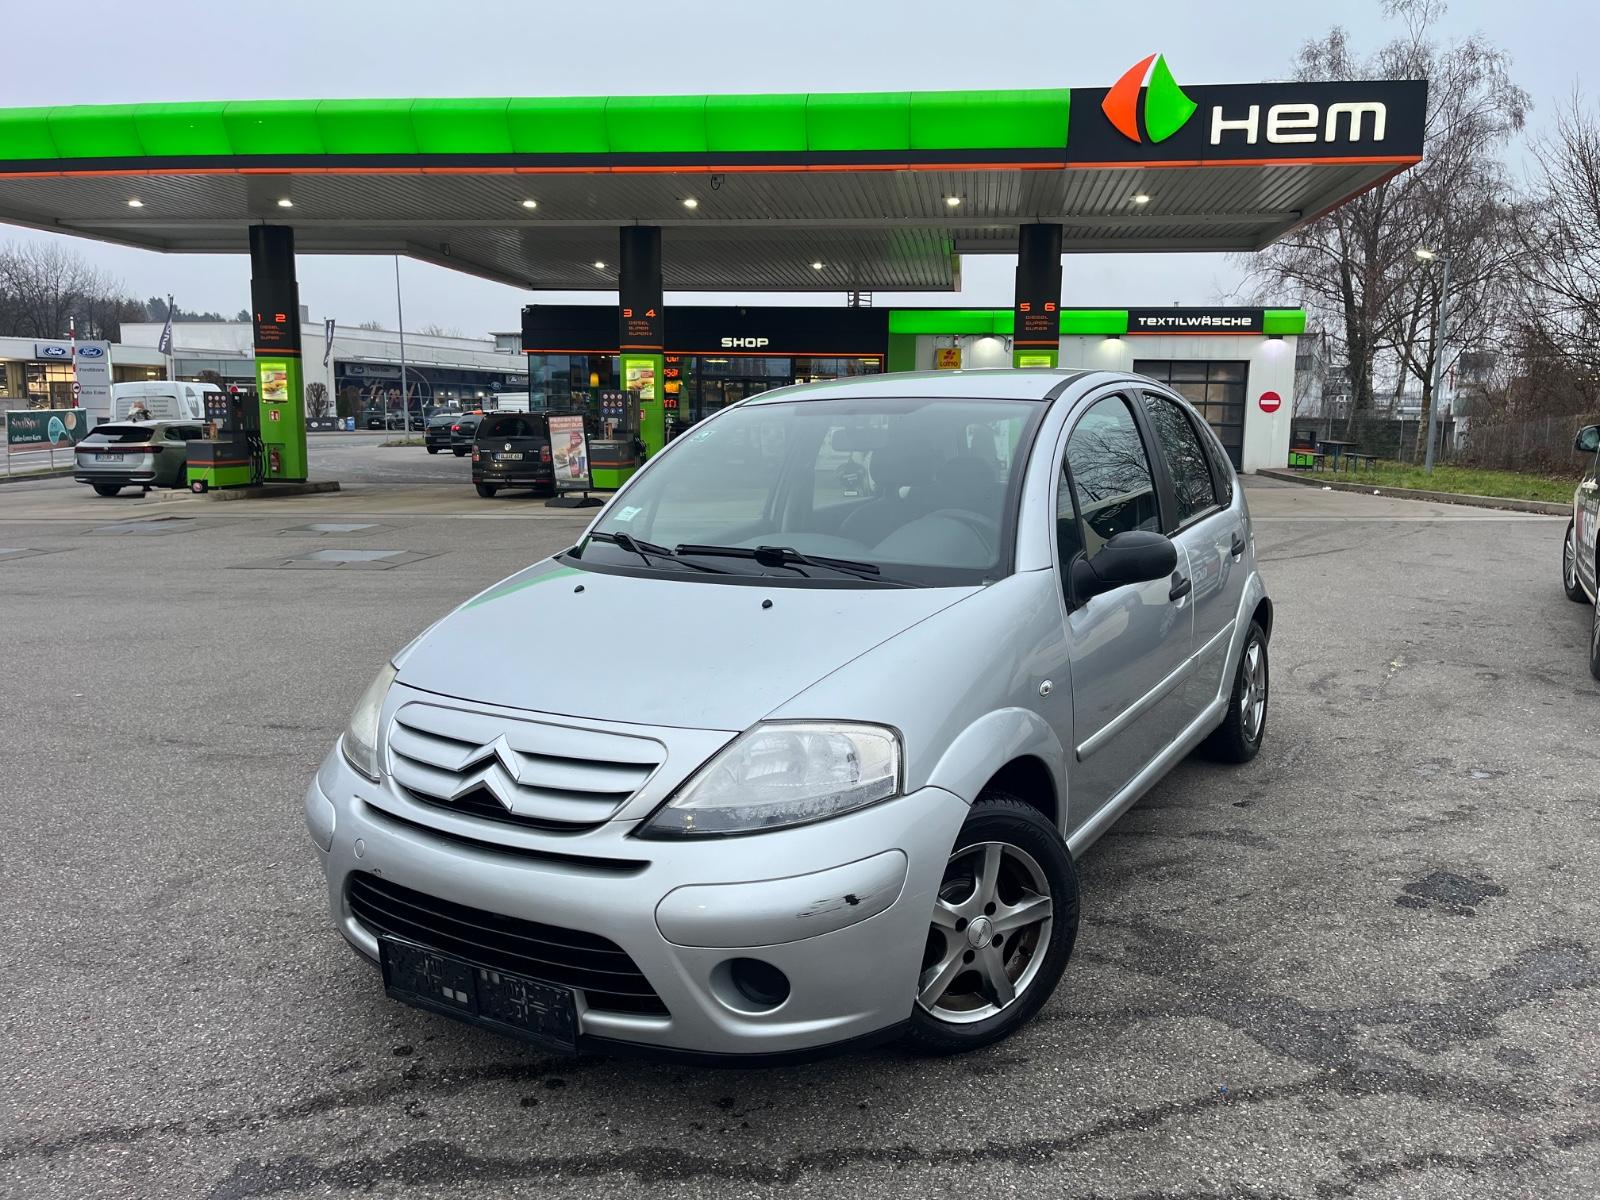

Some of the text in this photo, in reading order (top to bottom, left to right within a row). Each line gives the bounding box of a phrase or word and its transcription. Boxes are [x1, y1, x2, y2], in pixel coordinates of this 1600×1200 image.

[1019, 302, 1056, 312] 5 6
[257, 312, 287, 323] 1 2
[623, 308, 657, 318] 3 4
[721, 337, 769, 348] SHOP
